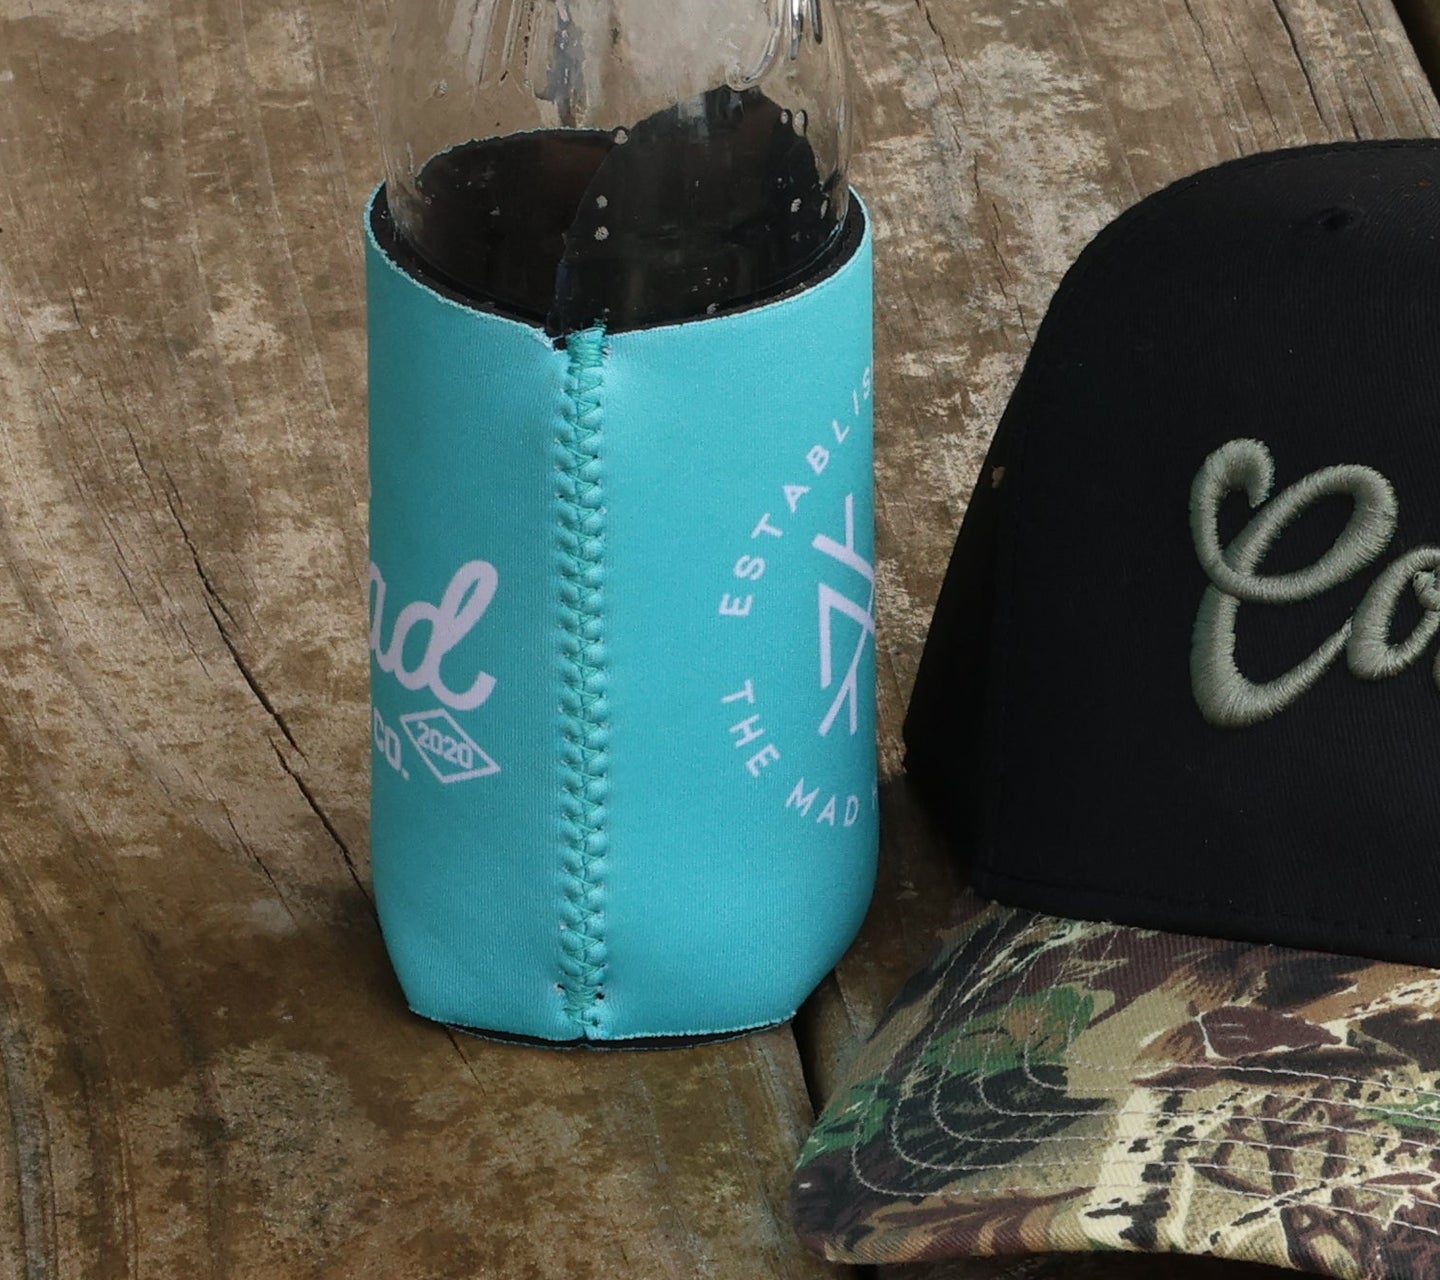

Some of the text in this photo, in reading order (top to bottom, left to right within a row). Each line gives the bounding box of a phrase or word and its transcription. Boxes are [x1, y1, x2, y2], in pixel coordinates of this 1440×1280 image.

[416, 720, 475, 770] 2020
[720, 678, 781, 778] THE
[785, 776, 860, 827] MAD
